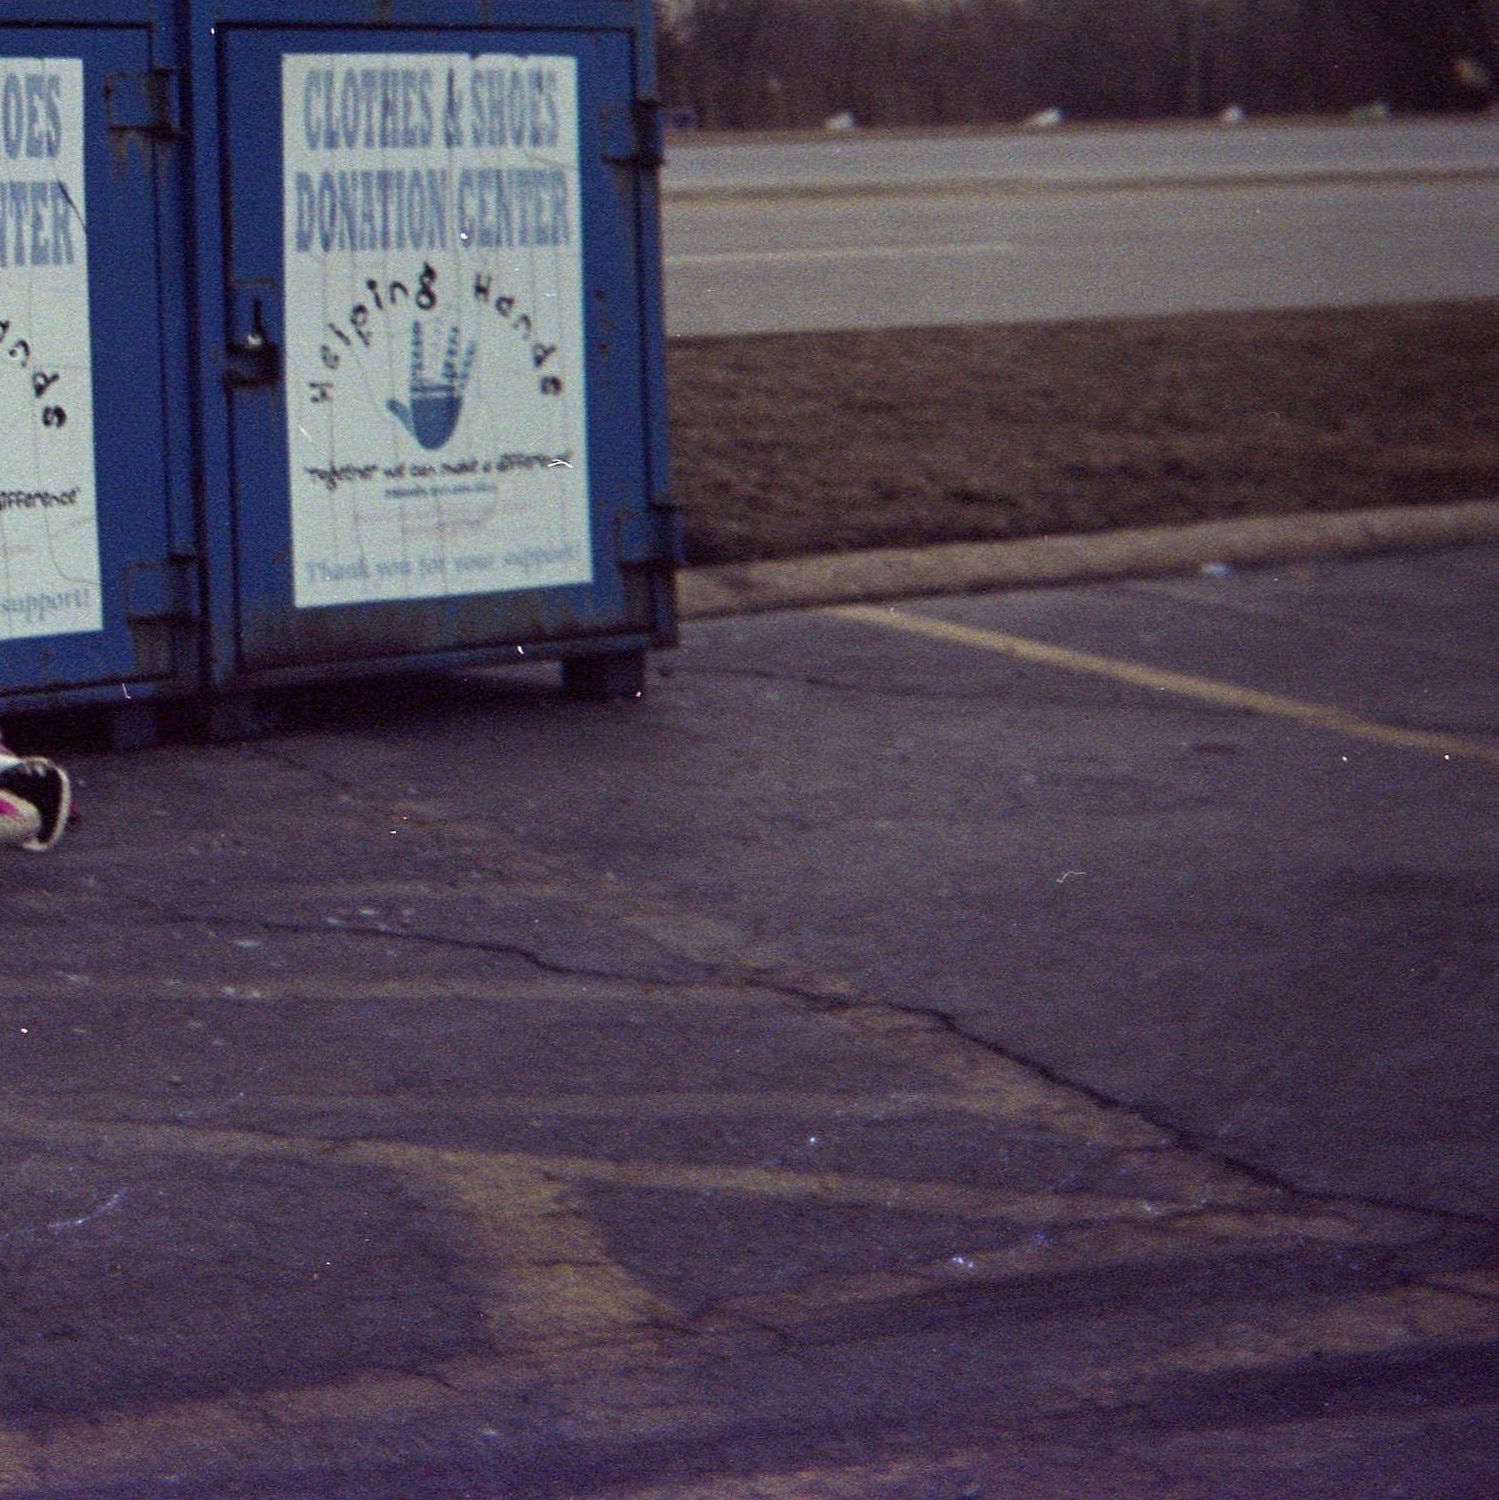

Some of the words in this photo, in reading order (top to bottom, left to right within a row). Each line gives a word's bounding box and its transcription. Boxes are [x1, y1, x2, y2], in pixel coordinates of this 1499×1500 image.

[303, 68, 433, 150] CLOTHES
[444, 68, 463, 148] &
[471, 68, 560, 148] SHOES
[296, 169, 449, 252] DONATION
[457, 168, 570, 248] CENTER
[308, 262, 437, 403] Helping
[475, 273, 562, 396] Hands
[1, 588, 91, 624] support!
